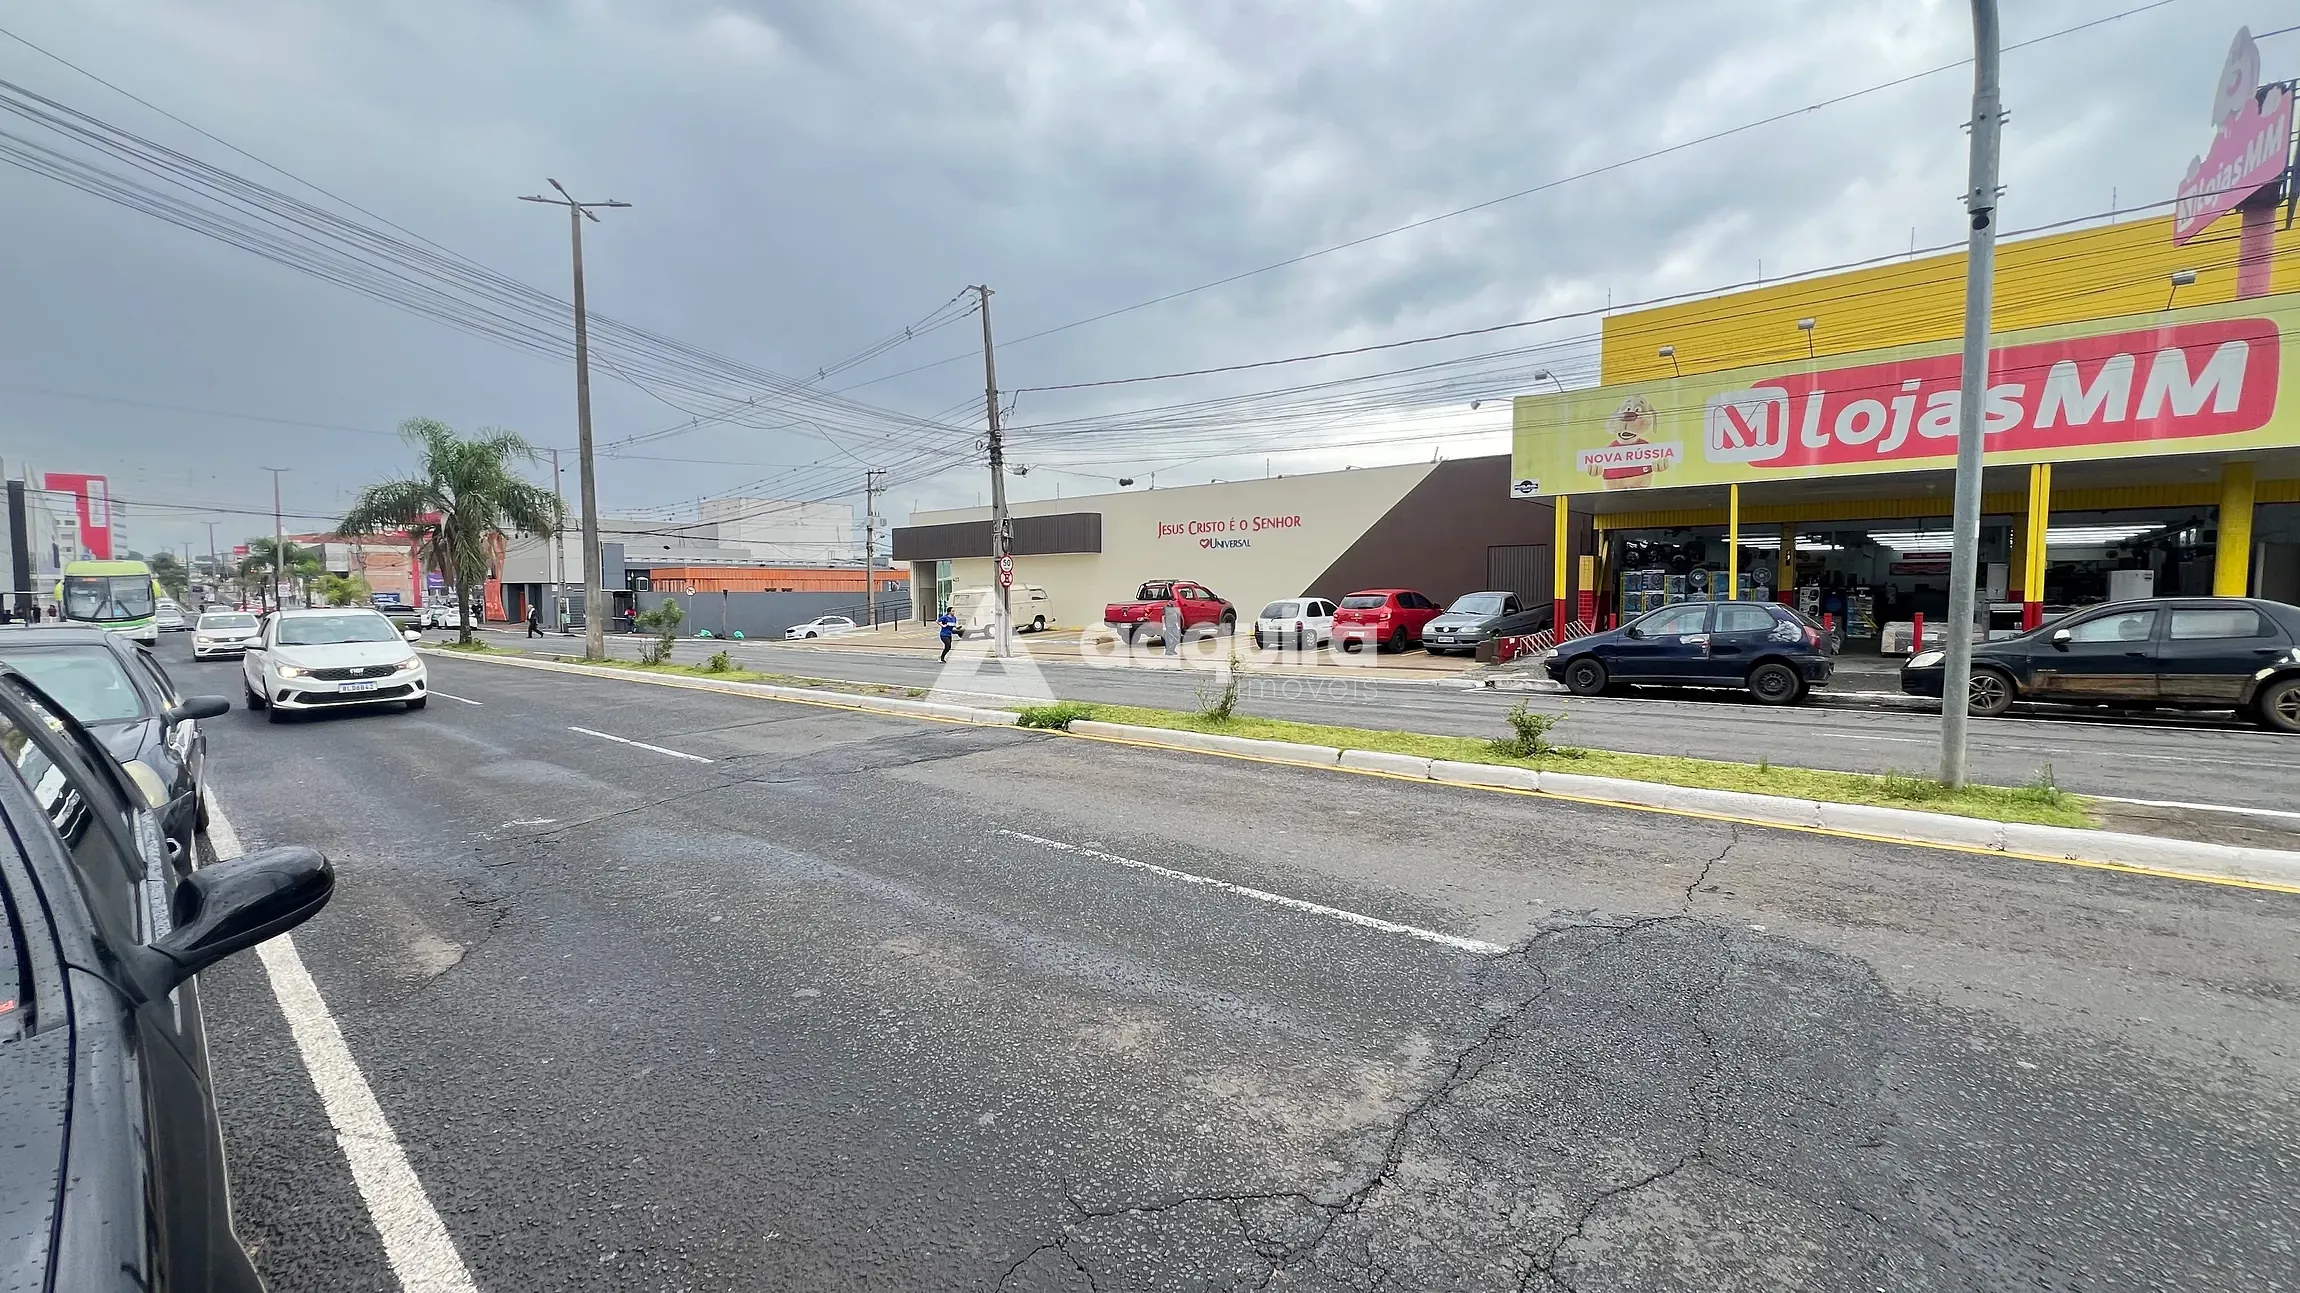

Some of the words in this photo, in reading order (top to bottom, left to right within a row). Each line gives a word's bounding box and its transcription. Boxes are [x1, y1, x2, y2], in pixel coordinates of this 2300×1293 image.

[1584, 452, 1623, 465] NOVA
[1625, 447, 1674, 461] RÚSSIA
[1157, 521, 1185, 539] JESUS
[1188, 520, 1225, 535] CRISTO
[1229, 516, 1235, 531] É
[1239, 519, 1248, 531] O
[1252, 515, 1301, 531] SENHOR
[1209, 537, 1252, 549] UNIVERSAL
[1002, 559, 1011, 567] 50
